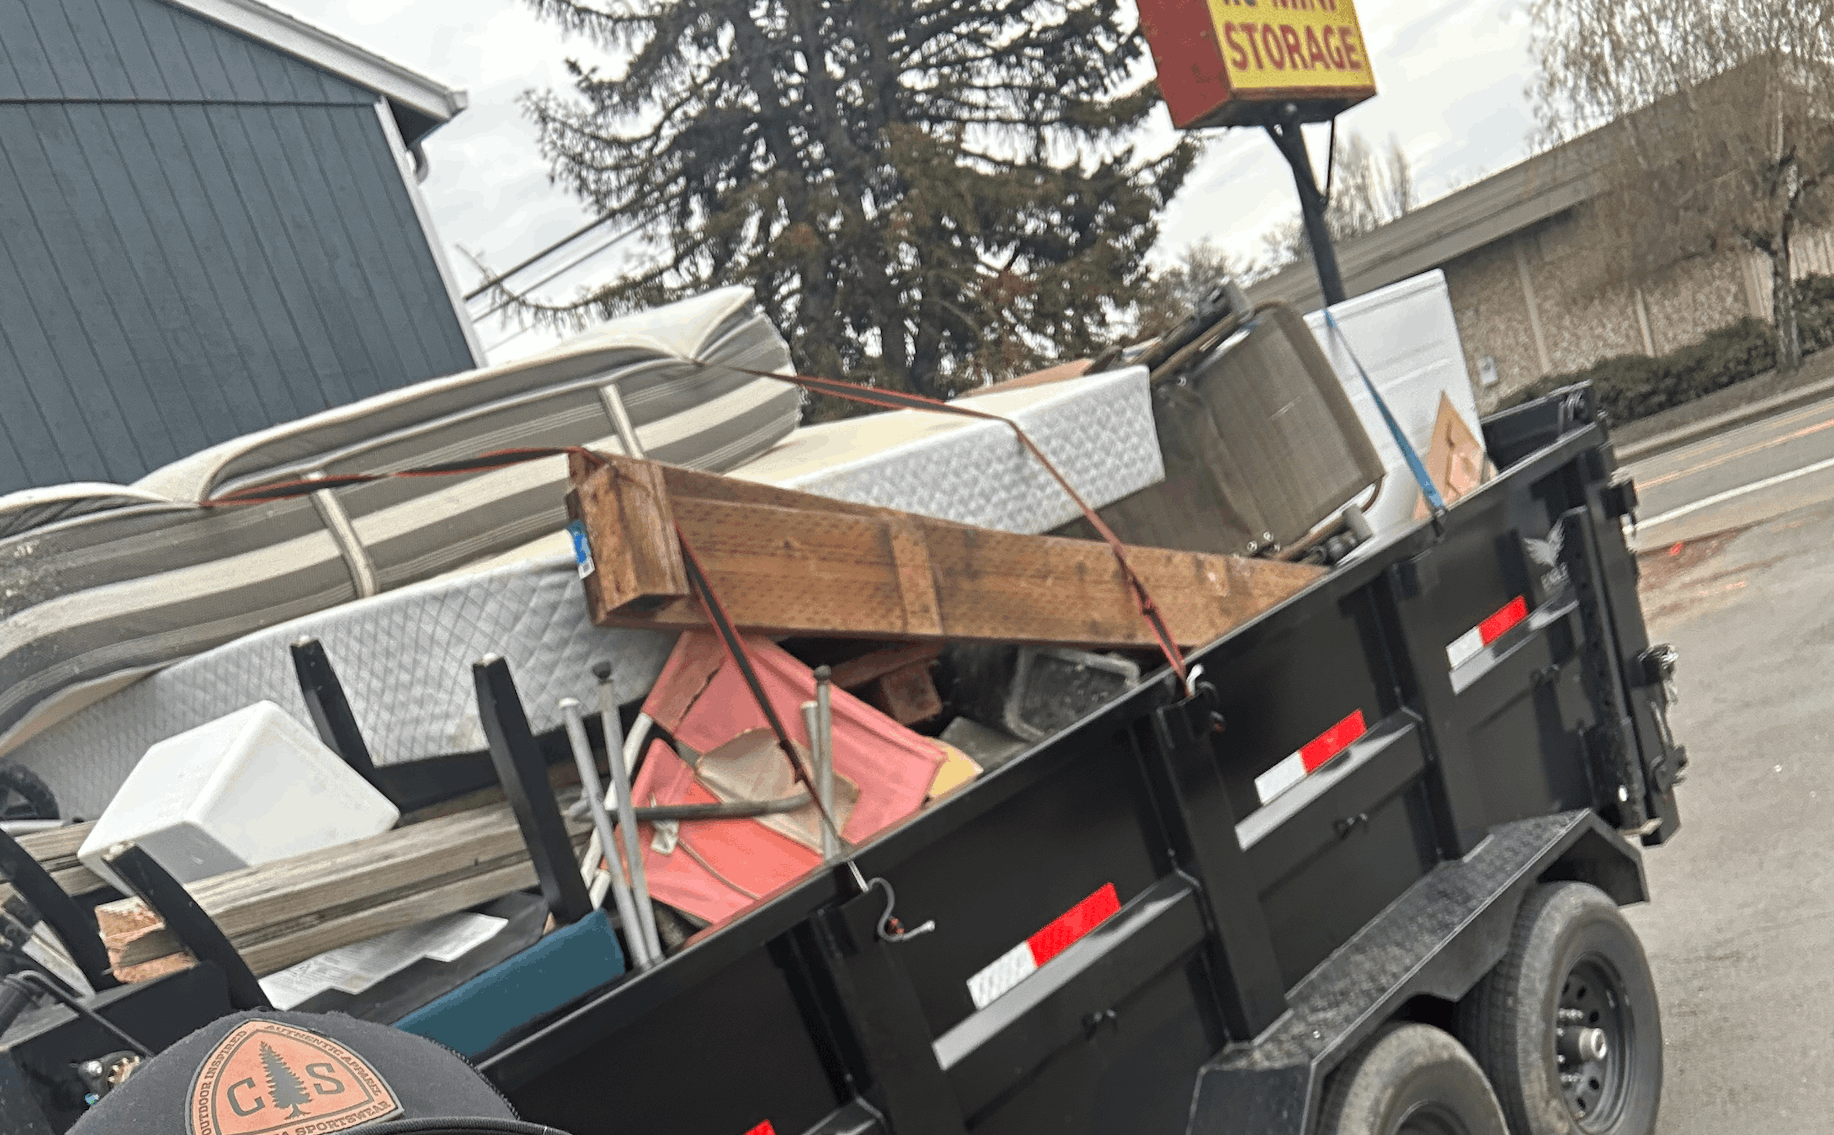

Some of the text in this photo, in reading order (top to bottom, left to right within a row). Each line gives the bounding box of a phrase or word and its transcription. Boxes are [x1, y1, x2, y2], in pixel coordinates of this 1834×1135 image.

[1224, 22, 1361, 71] STORAGE
[204, 1030, 247, 1079] INSPIRED
[264, 1025, 382, 1096] AUTHENTIC APPAREL
[227, 1063, 345, 1117] C S
[295, 1101, 391, 1135] SPORTSWEAR
